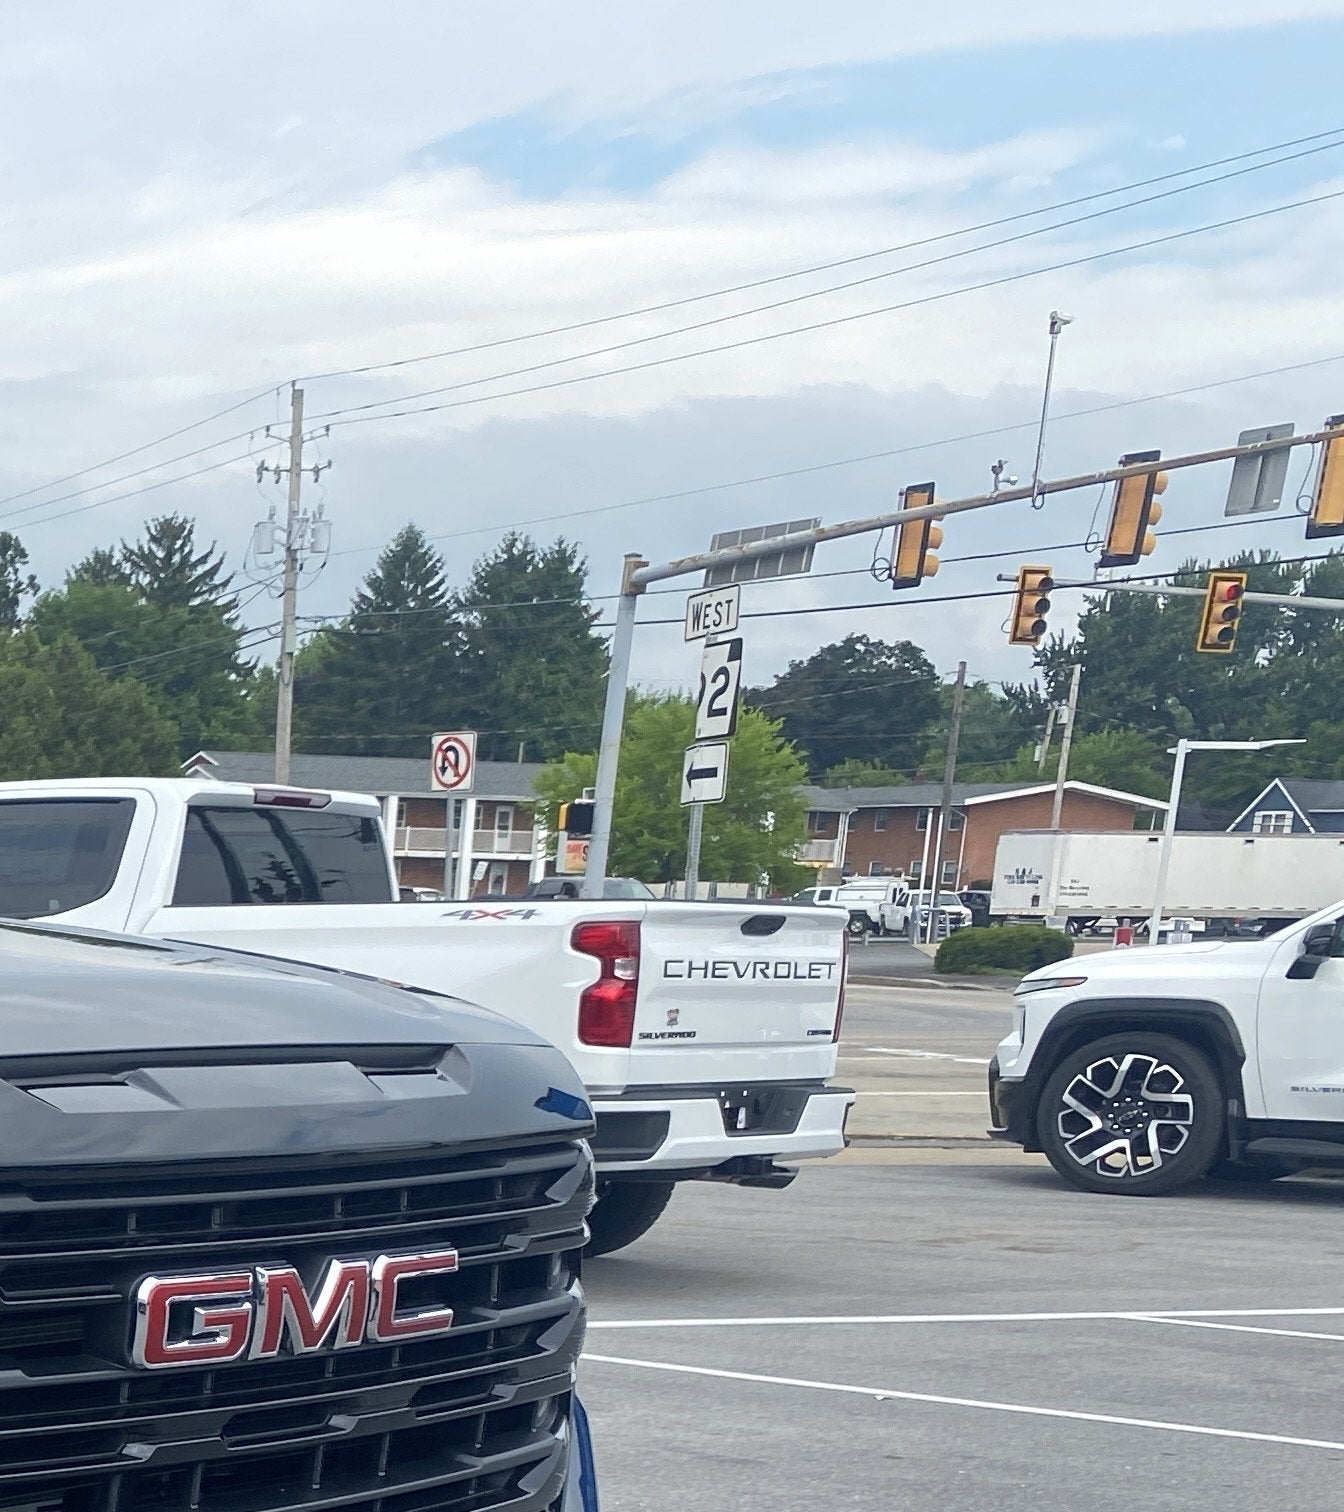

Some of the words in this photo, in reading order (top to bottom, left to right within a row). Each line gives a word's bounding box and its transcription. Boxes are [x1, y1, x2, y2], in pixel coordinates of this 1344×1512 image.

[692, 599, 733, 632] WEST
[697, 666, 730, 718] 2
[663, 960, 836, 979] CHEVROLET
[638, 1031, 697, 1040] SILVERADO
[132, 1248, 459, 1370] GMC
